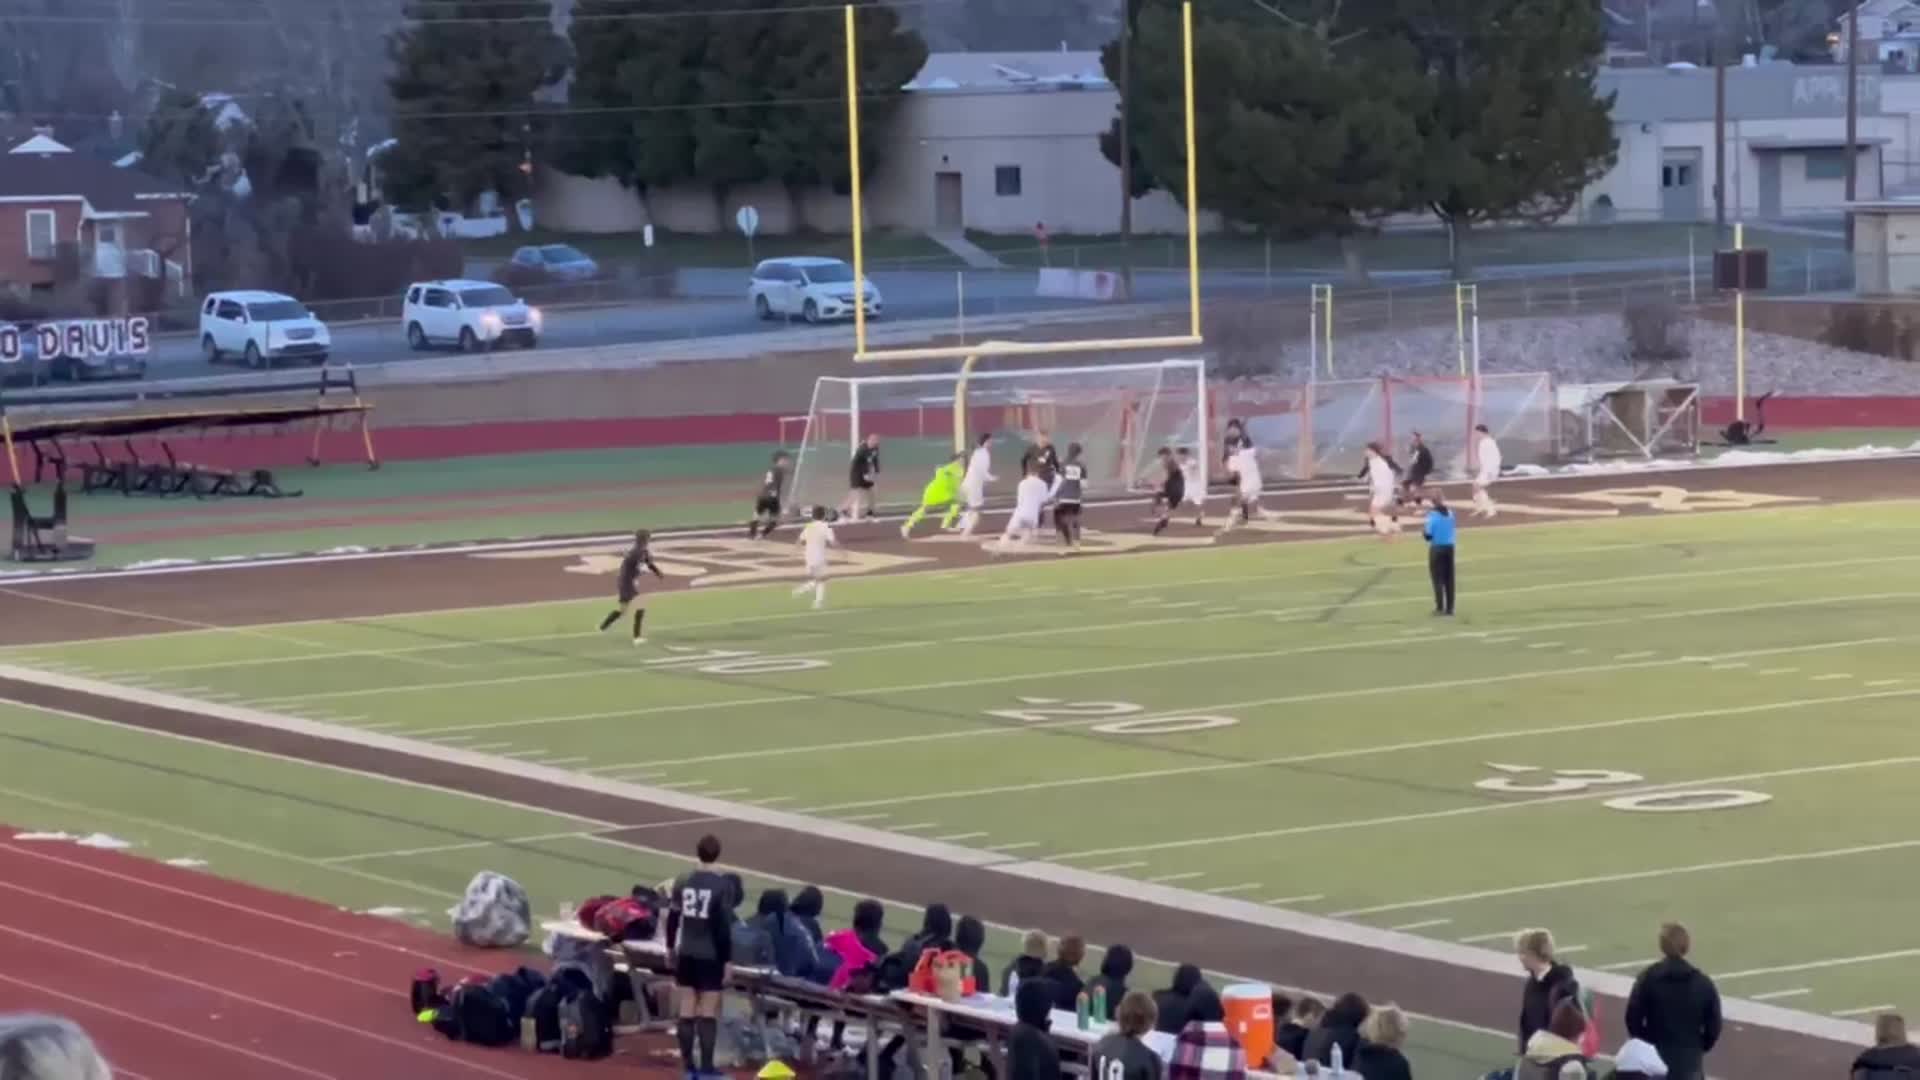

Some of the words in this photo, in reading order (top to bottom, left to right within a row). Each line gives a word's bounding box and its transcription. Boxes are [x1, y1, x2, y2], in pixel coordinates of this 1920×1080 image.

[38, 317, 149, 360] DAVIS
[641, 649, 832, 674] 10
[980, 701, 1241, 733] 20
[1473, 769, 1774, 811] 30
[682, 888, 712, 919] 27
